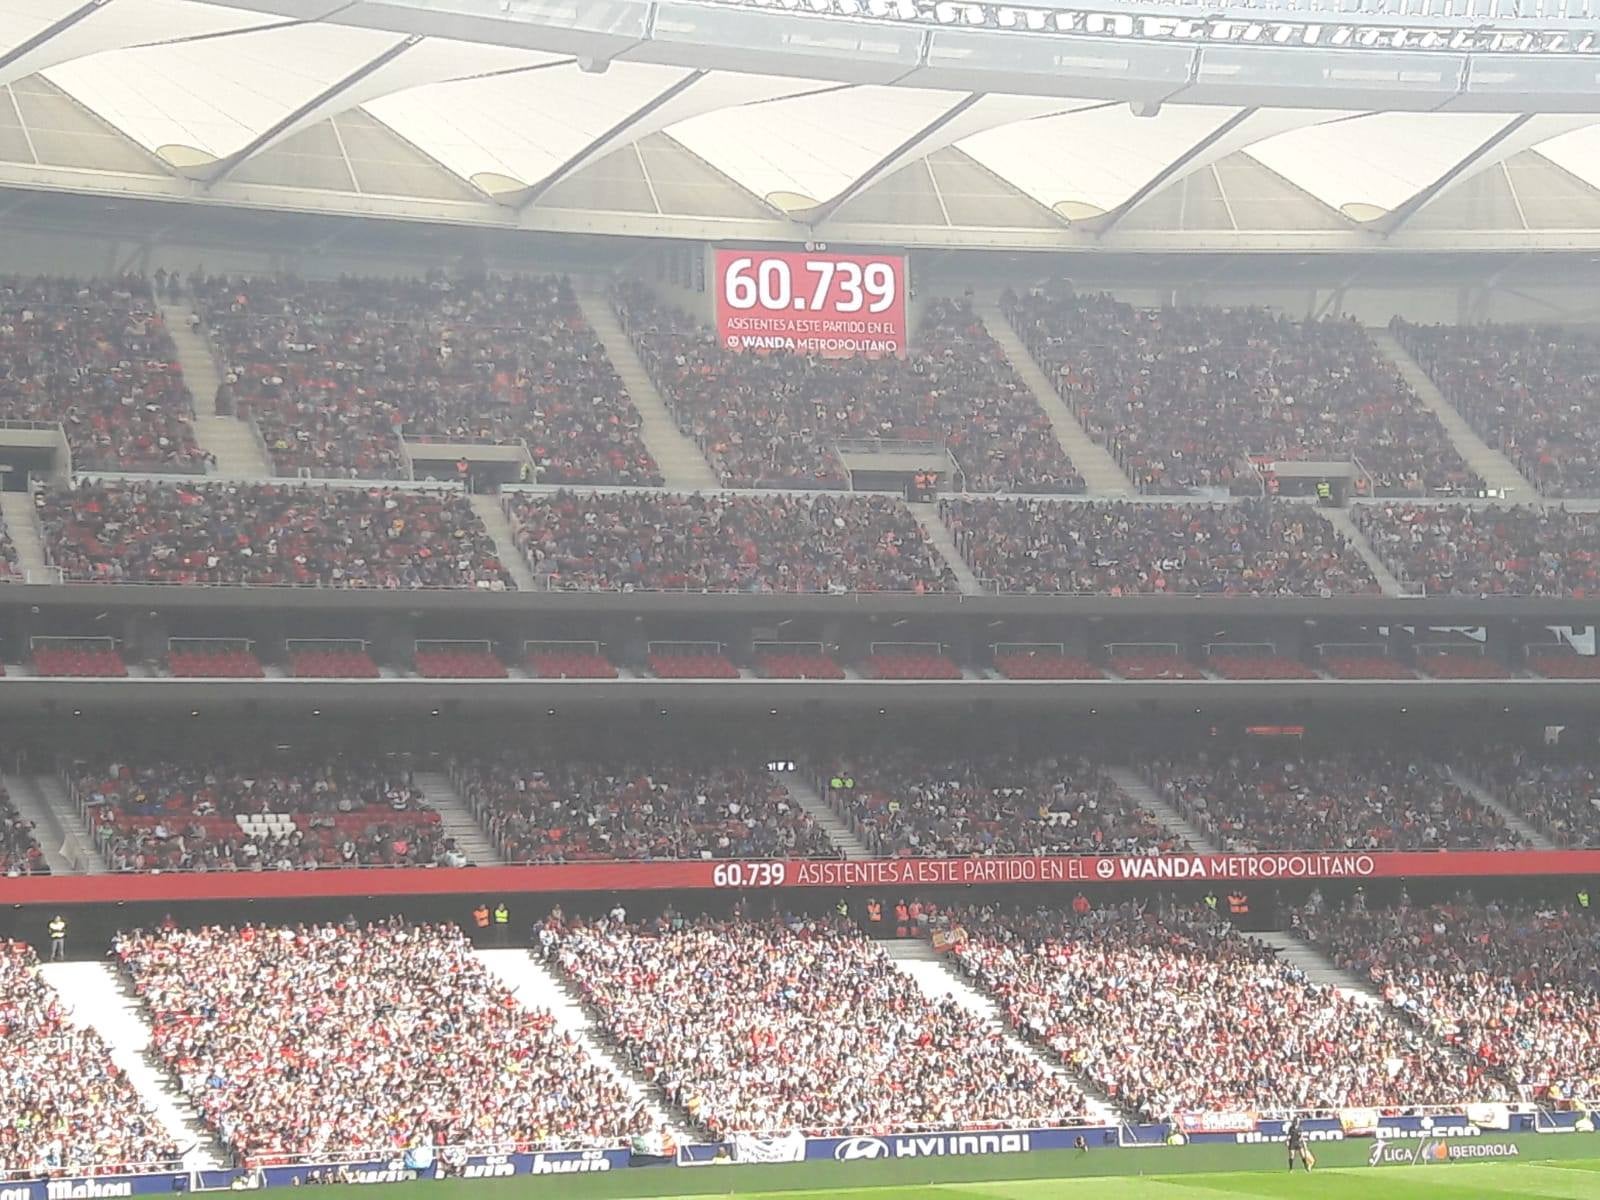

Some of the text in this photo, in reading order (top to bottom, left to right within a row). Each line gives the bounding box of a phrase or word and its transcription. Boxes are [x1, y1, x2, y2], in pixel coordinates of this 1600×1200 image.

[725, 258, 895, 312] 60.739
[727, 317, 895, 335] ASISTENTES A ESTE PARTIDO EN EL
[741, 335, 897, 352] WANDA METROPOLITANO
[713, 855, 1374, 887] 60.739 ASISTENTES A ESTE PARTIDO EN EL WANDA METROPOLITANO
[1384, 1143, 1519, 1162] LIGA IBERDROLA
